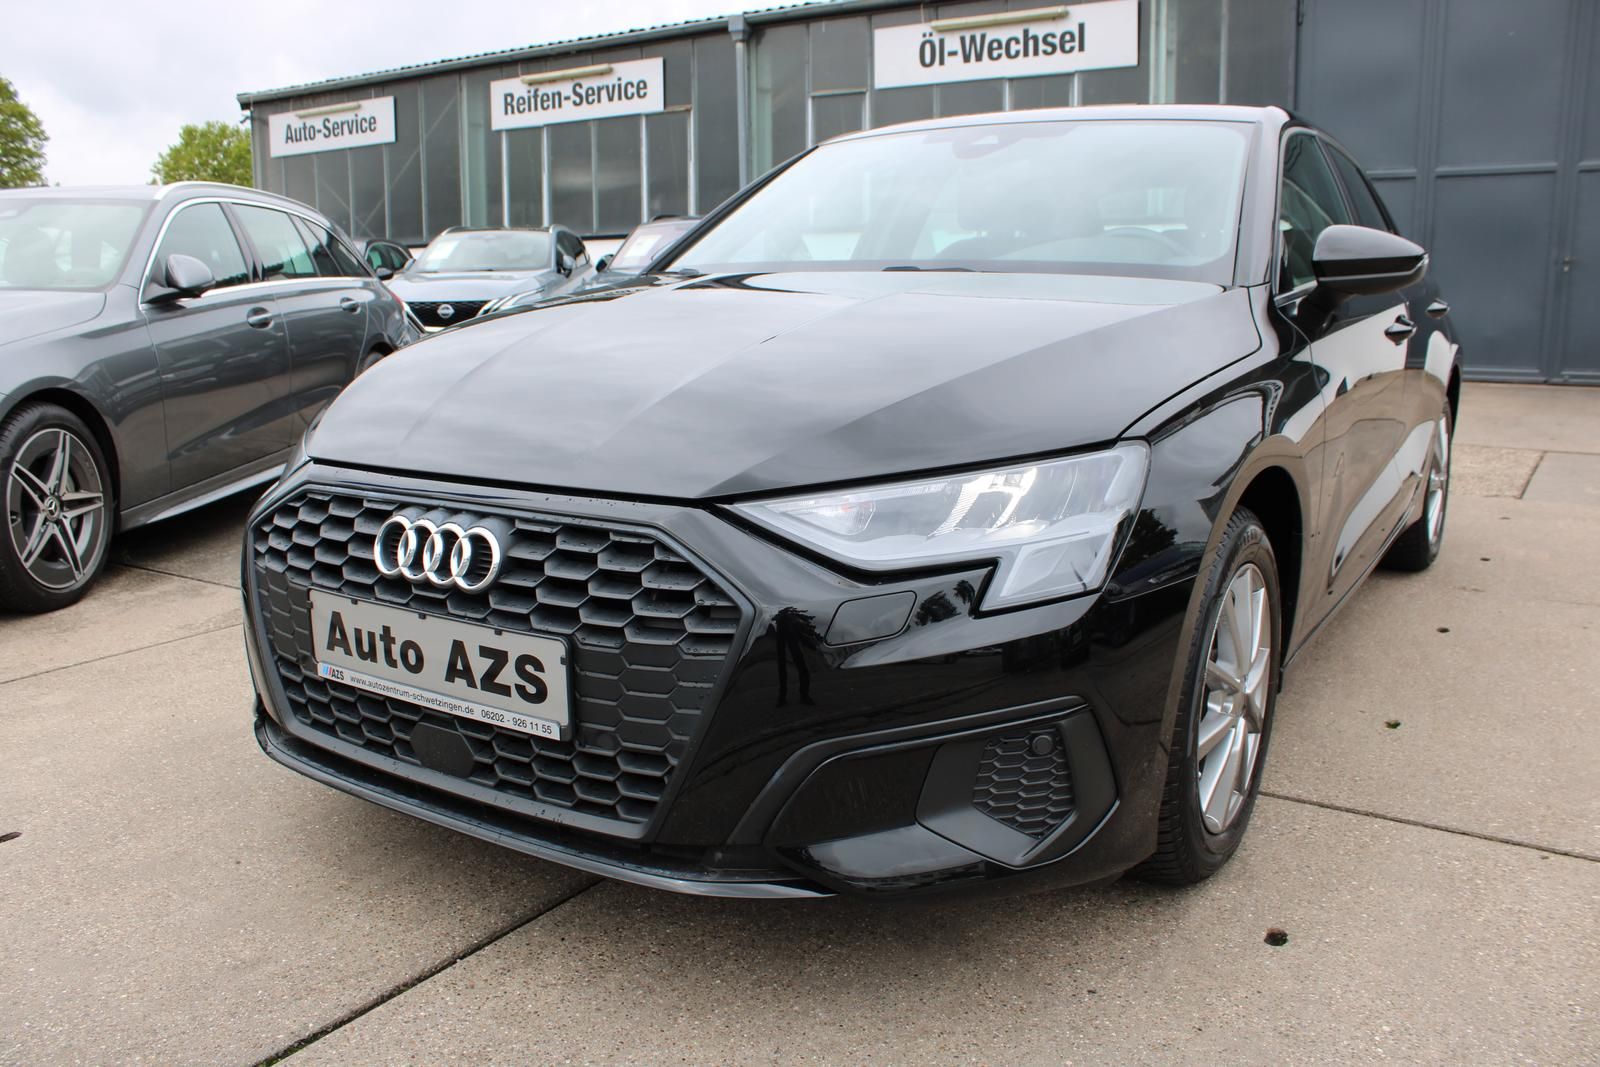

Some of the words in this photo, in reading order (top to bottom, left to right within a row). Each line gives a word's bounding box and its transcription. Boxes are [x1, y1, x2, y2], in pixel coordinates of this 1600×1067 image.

[919, 22, 1086, 68] Öl-Wechsel
[503, 78, 648, 116] Reifen-Service
[284, 113, 377, 145] Auto-Service
[326, 610, 425, 674] Auto
[444, 639, 548, 705] AZS
[331, 669, 345, 681] AZS
[350, 675, 475, 715] www.autozentrum-schwetzingen.de
[481, 709, 505, 723] 06202
[512, 717, 528, 729] 926
[530, 721, 539, 732] 11
[541, 725, 552, 735] 55
